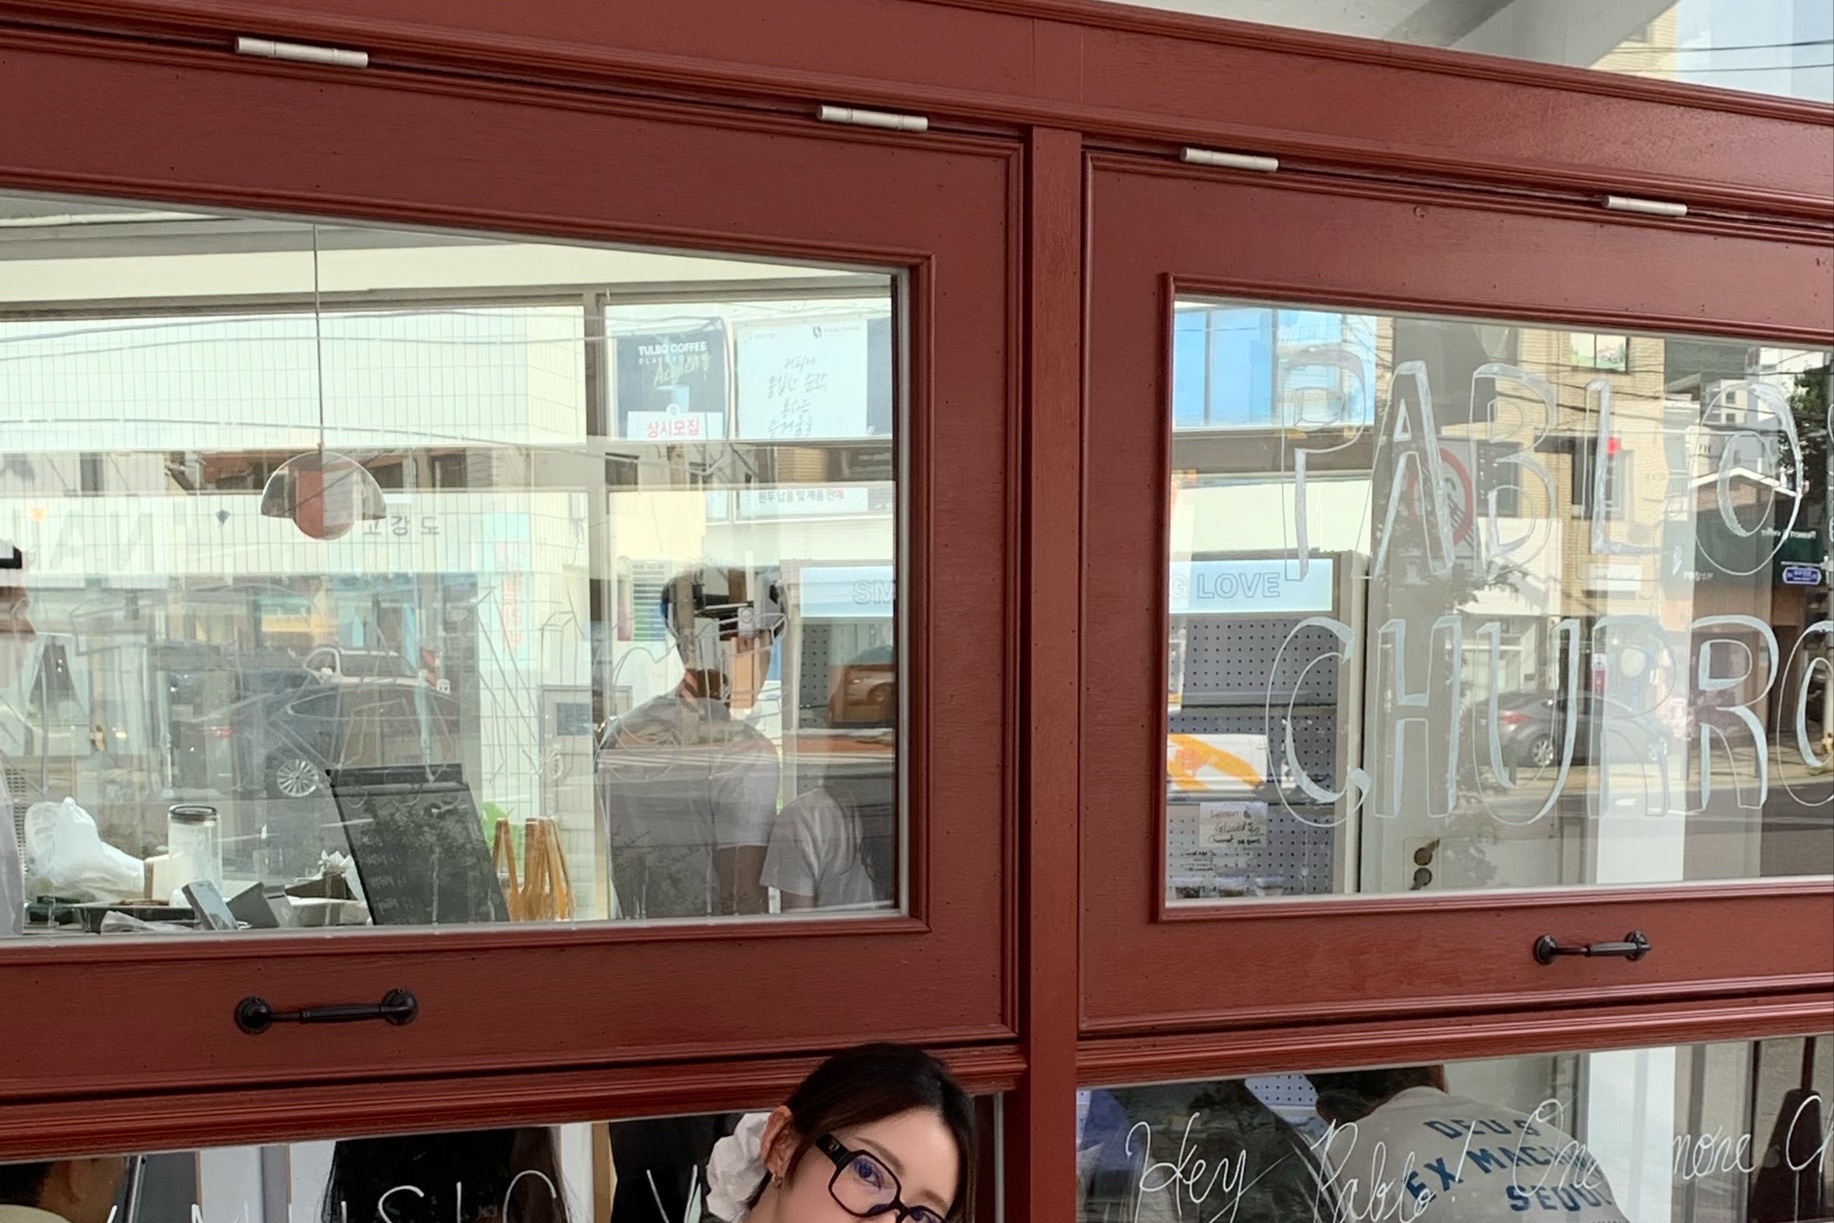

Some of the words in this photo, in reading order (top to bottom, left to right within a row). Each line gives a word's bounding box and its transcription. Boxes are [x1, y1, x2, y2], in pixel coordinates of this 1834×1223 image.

[637, 343, 670, 356] TULBO
[670, 341, 708, 353] COFFEE
[647, 418, 700, 438] 상시모집
[1280, 347, 1834, 582] PABLO
[1196, 572, 1281, 600] LOVE
[1423, 1118, 1541, 1139] DEUS
[1673, 1126, 1757, 1180] more
[1404, 1157, 1463, 1203] EX
